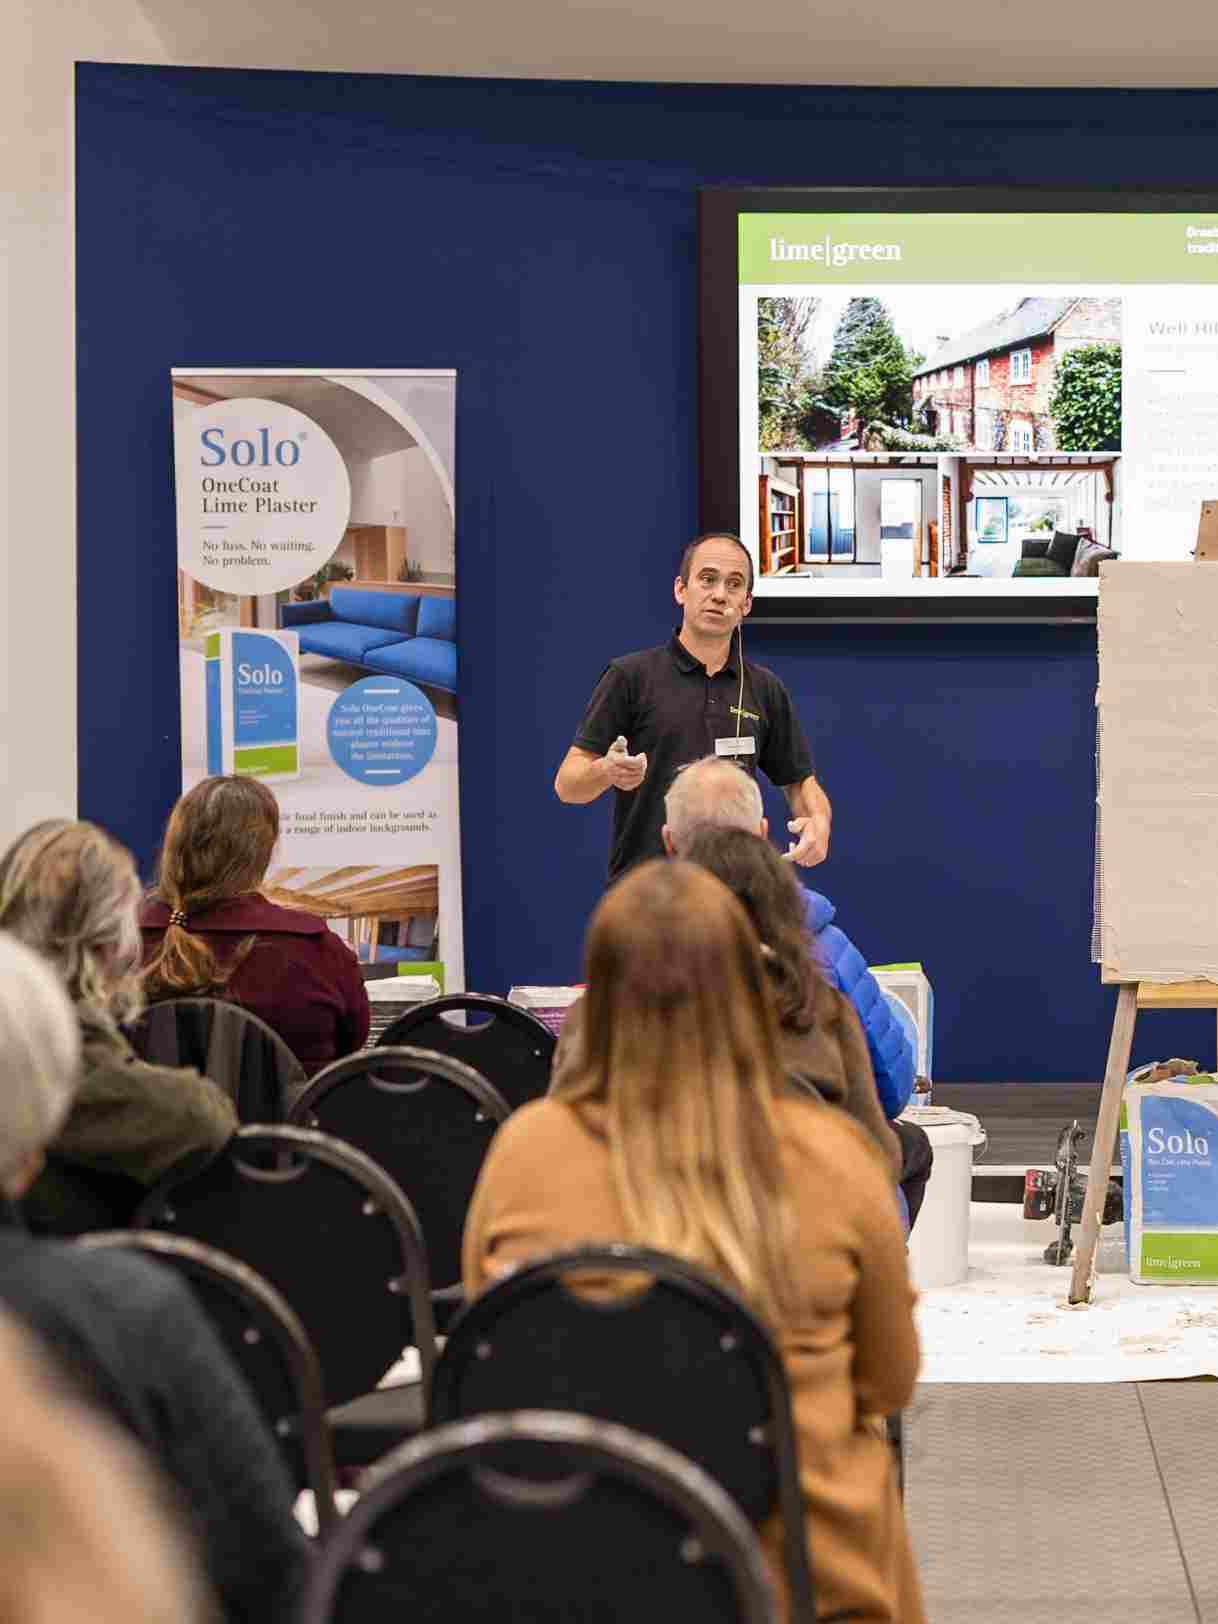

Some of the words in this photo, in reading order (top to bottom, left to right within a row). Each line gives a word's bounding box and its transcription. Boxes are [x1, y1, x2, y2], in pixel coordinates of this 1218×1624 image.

[1148, 321, 1188, 336] Well
[200, 427, 300, 466] Solo
[202, 477, 279, 493] OneCoat
[202, 497, 248, 513] Lime
[256, 497, 318, 513] Plaster
[202, 541, 219, 551] No
[250, 541, 267, 551] No
[203, 555, 219, 566] No
[238, 663, 283, 685] Solo
[1147, 1127, 1209, 1155] Solo
